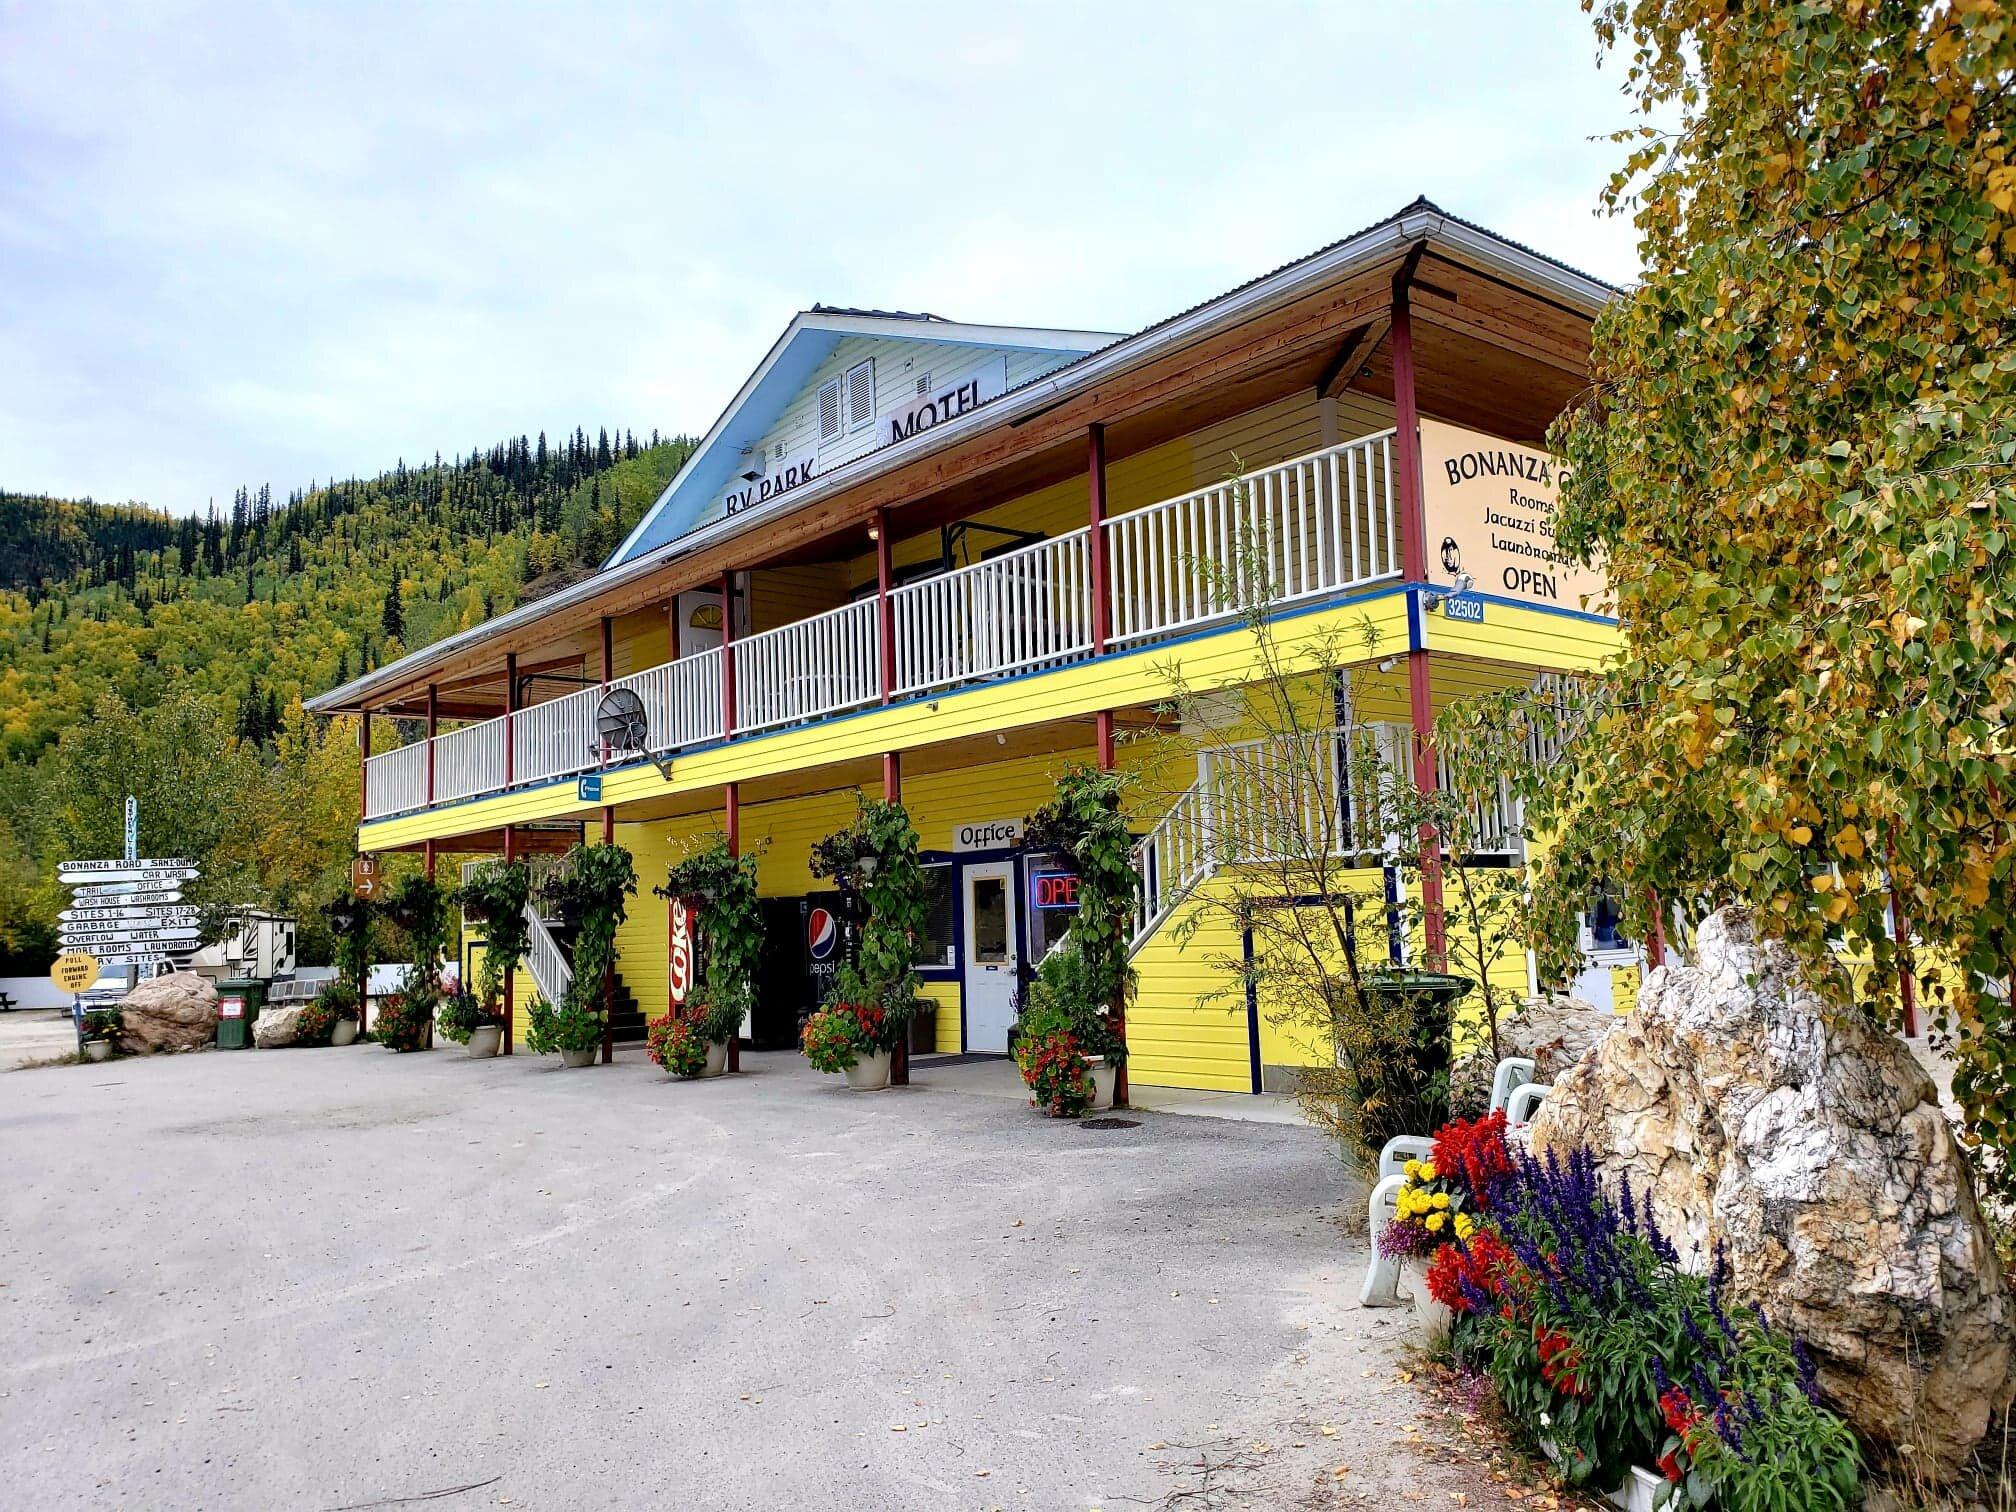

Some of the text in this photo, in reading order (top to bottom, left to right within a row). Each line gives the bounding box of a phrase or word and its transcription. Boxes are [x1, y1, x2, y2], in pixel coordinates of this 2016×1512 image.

[891, 378, 978, 442] MOTEL
[1444, 451, 1549, 486] BONANZA
[726, 457, 815, 516] RV PARK
[1510, 488, 1555, 514] Rooms
[1484, 507, 1535, 533] Jacuzzi
[1502, 567, 1557, 599] OPEN
[1448, 599, 1481, 619] 32502
[960, 823, 1016, 848] Office
[63, 861, 110, 870] BONANZA
[115, 860, 142, 869] ROAD
[142, 870, 187, 879] CAR WASH
[80, 881, 163, 896] TRAIL OFFICE
[1037, 877, 1082, 905] OPE
[79, 893, 169, 907] WASH HOUSE WASHROOMS
[71, 909, 105, 919] SITES
[145, 906, 173, 917] SITES
[175, 906, 196, 915] 17-28
[67, 921, 120, 931] GARBAGE
[161, 918, 191, 927] EXIT
[67, 930, 159, 944] OVERFLOW WATER
[67, 940, 198, 955] MORE ROOMS LAUNDROMAT
[61, 965, 89, 974] FORWARD
[809, 959, 835, 977] pepsi
[63, 973, 88, 982] ENGINE
